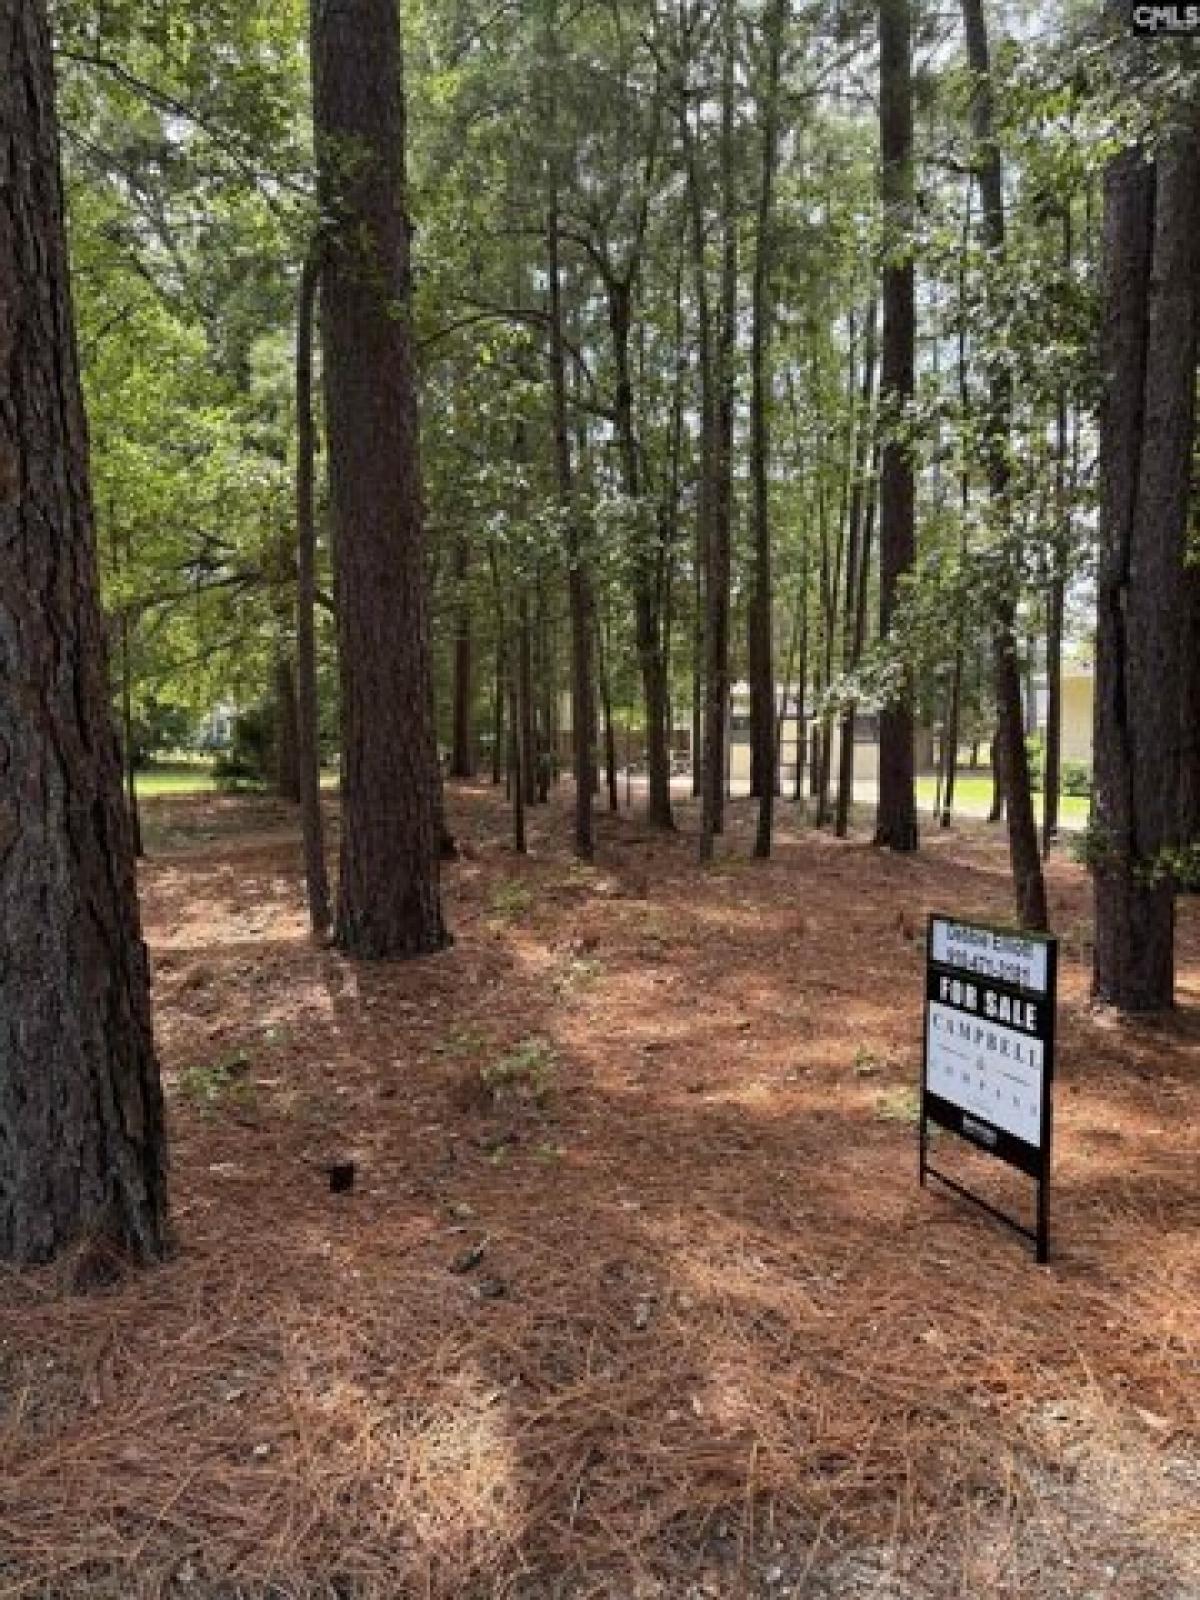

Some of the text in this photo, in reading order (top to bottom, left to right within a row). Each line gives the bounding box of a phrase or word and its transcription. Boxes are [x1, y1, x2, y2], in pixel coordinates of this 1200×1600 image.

[940, 976, 1037, 1030] FOR SALE
[932, 1012, 1042, 1070] CAMPBELL
